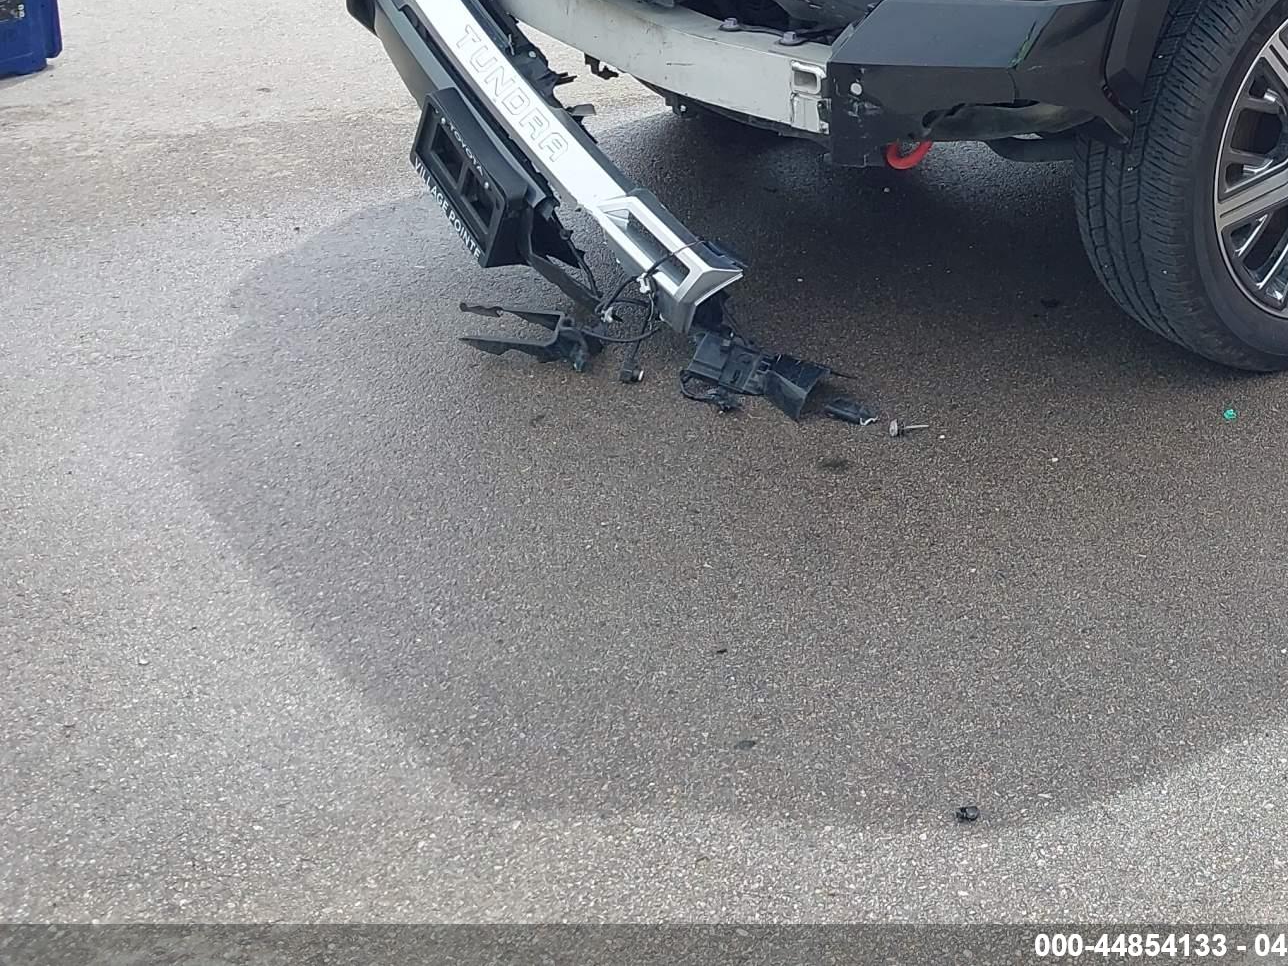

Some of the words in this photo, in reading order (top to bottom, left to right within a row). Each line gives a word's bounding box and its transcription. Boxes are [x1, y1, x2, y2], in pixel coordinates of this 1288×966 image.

[456, 24, 569, 162] TUNDRA
[449, 121, 484, 176] TOYOTA
[414, 157, 449, 214] VILLAGE
[448, 211, 481, 259] POINTE
